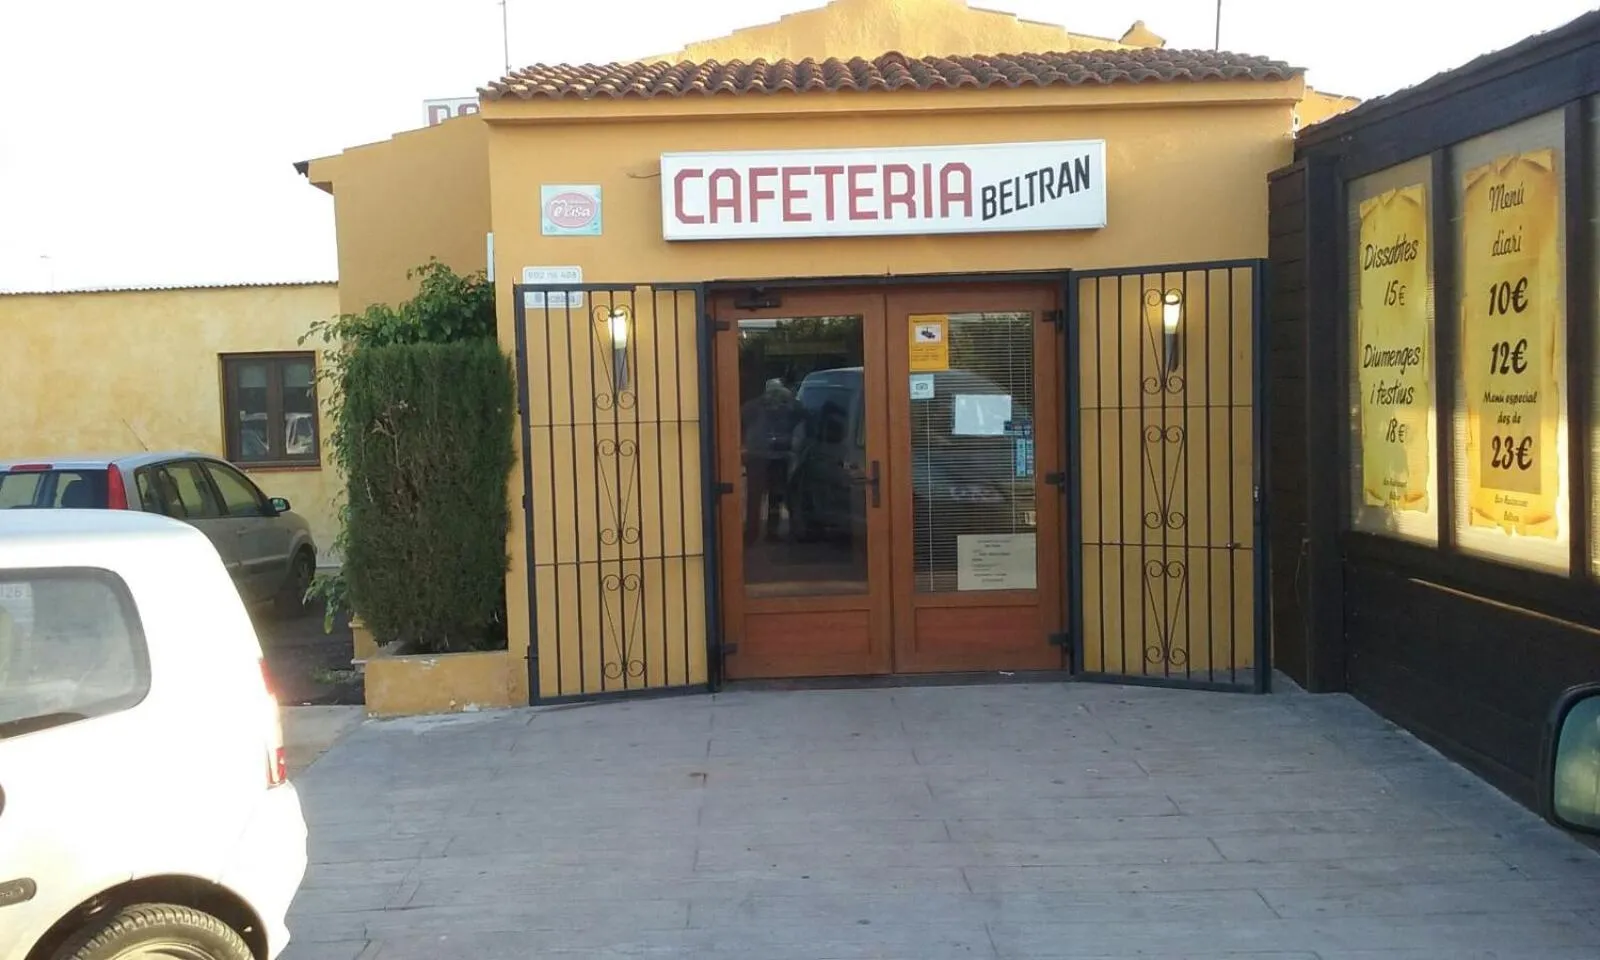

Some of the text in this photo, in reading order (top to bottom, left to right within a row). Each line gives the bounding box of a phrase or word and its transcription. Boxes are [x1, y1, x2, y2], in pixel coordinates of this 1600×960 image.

[673, 154, 1091, 224] CAFETERIA BELTRAN
[1489, 181, 1525, 213] Menú
[1363, 233, 1419, 271] Dissabtes
[1491, 224, 1522, 257] diari
[1489, 276, 1529, 317] 10€
[1363, 344, 1421, 375] Diumenges
[1490, 338, 1528, 375] 12€
[1370, 380, 1414, 405] i festius
[1505, 390, 1538, 405] especial
[1491, 434, 1532, 471] 23€
